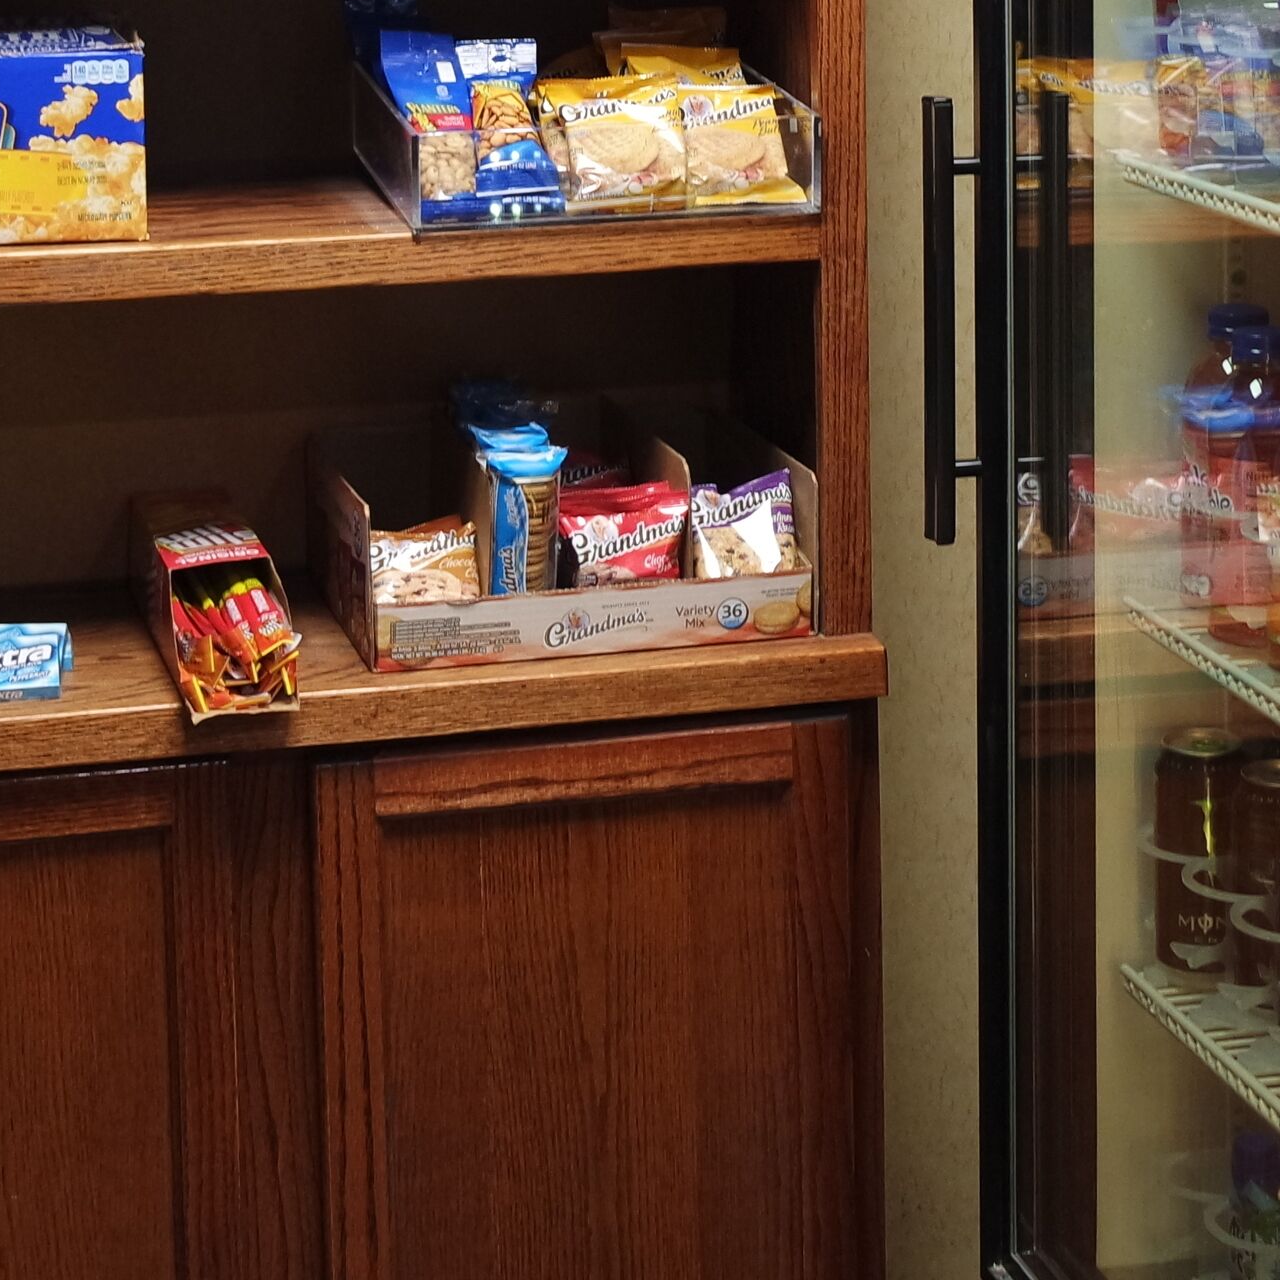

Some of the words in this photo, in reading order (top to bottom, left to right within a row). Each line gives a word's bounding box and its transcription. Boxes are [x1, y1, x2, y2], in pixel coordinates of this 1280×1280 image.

[572, 515, 685, 565] Grandma's
[675, 603, 716, 620] Variety
[721, 603, 743, 619] 36
[544, 608, 647, 649] Grandma's
[685, 618, 705, 629] Mix
[8, 670, 52, 684] PEPPERMINT
